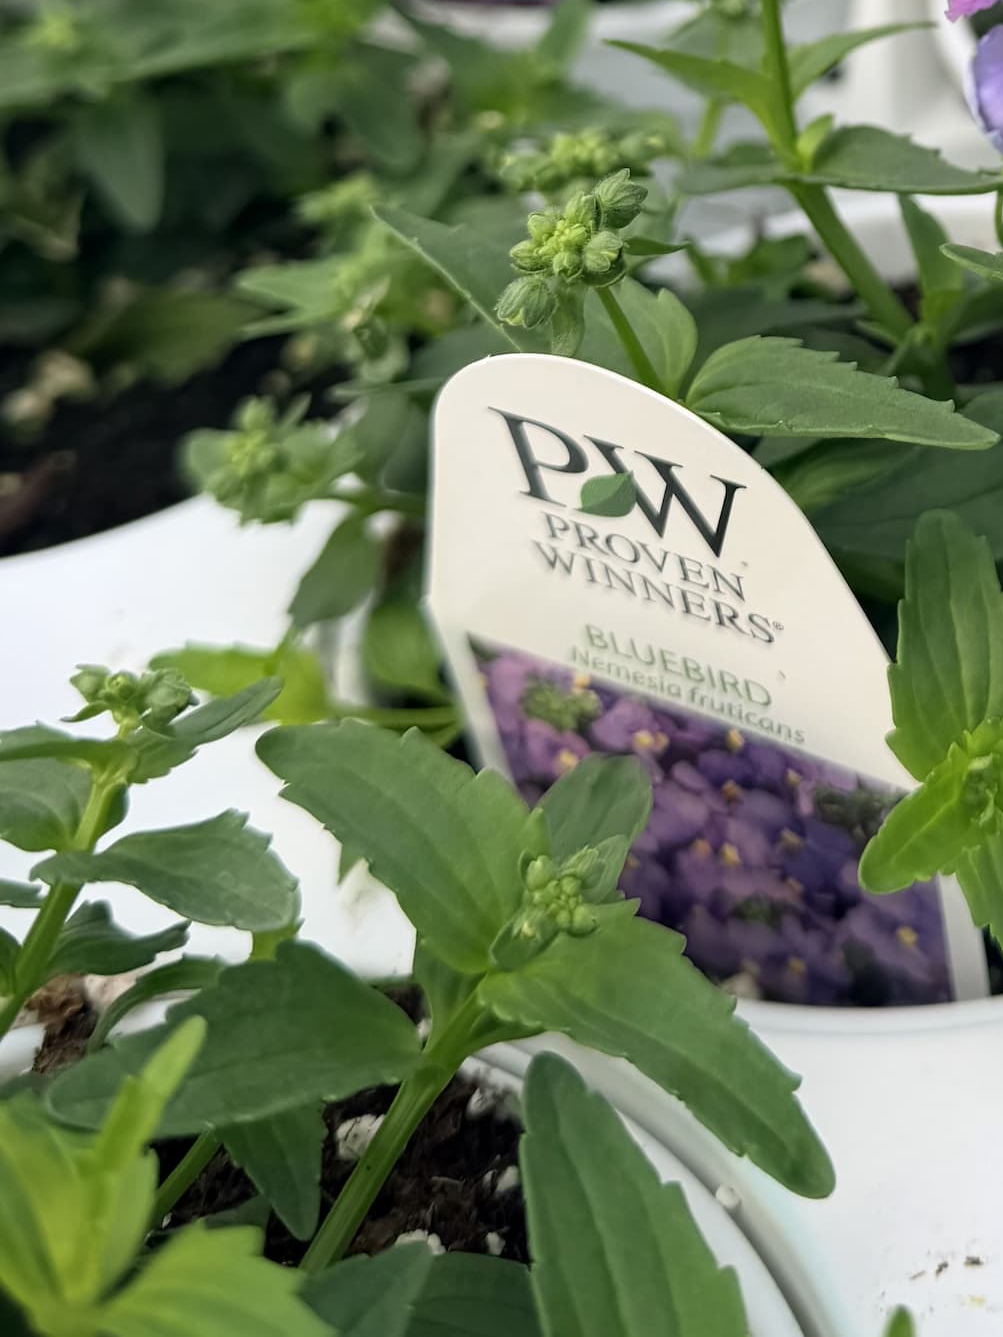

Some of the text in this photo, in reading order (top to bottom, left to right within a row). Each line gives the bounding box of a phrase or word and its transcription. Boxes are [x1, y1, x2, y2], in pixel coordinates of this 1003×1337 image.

[487, 405, 748, 559] PW
[541, 510, 745, 602] PROVEN
[570, 644, 807, 745] Nemesia fruticans
[584, 622, 773, 707] BLUEBIRD
